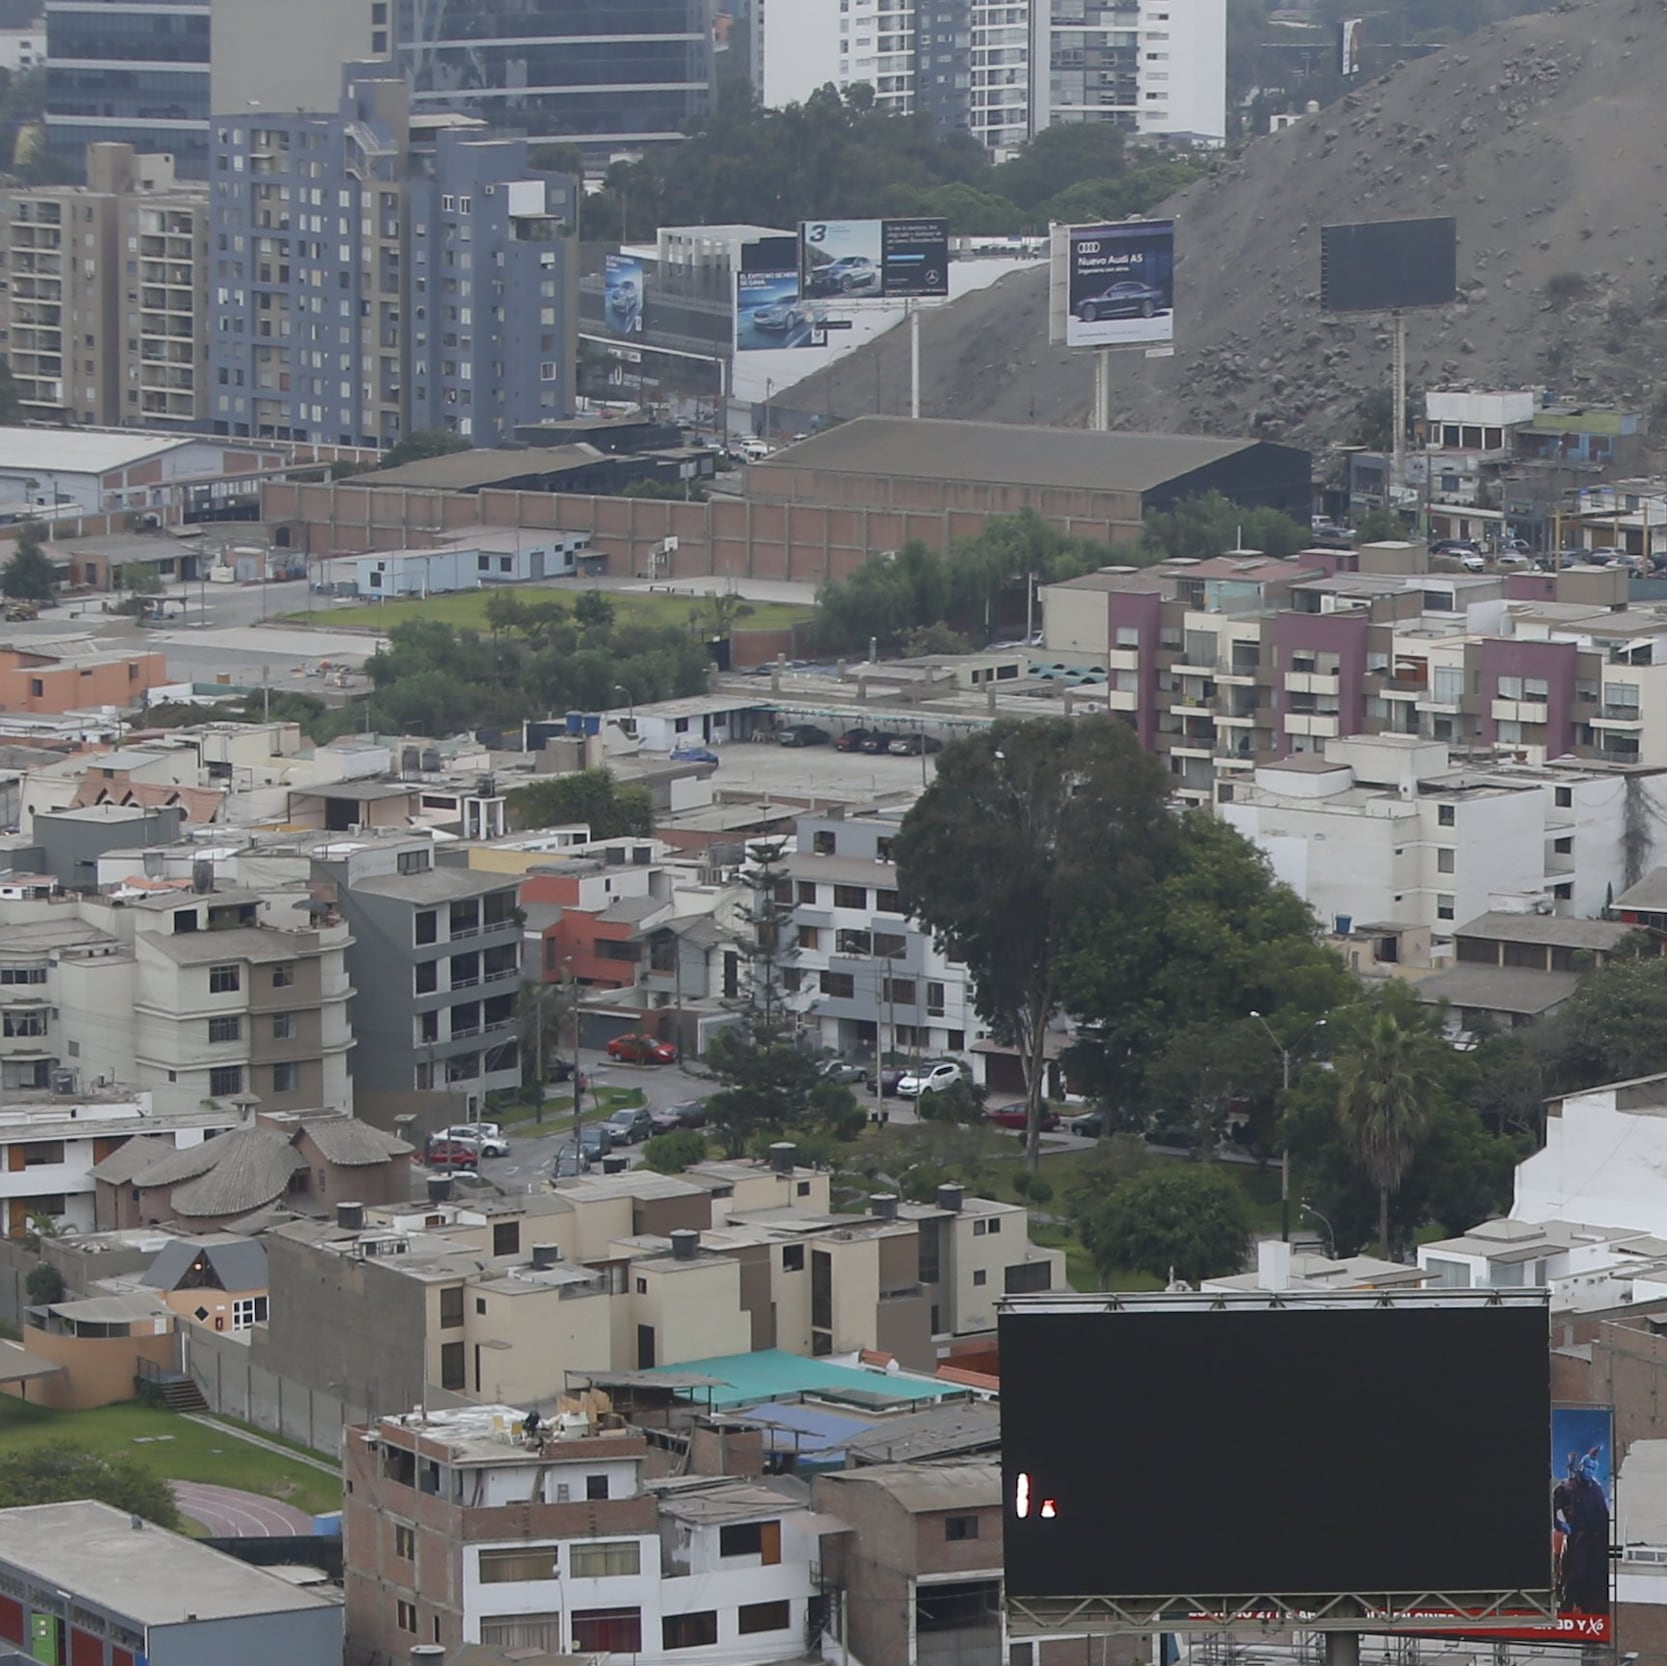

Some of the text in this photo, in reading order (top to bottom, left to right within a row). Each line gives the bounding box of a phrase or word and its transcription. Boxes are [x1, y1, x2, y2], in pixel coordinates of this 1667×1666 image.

[1078, 253, 1143, 266] Nuevo Audi A5
